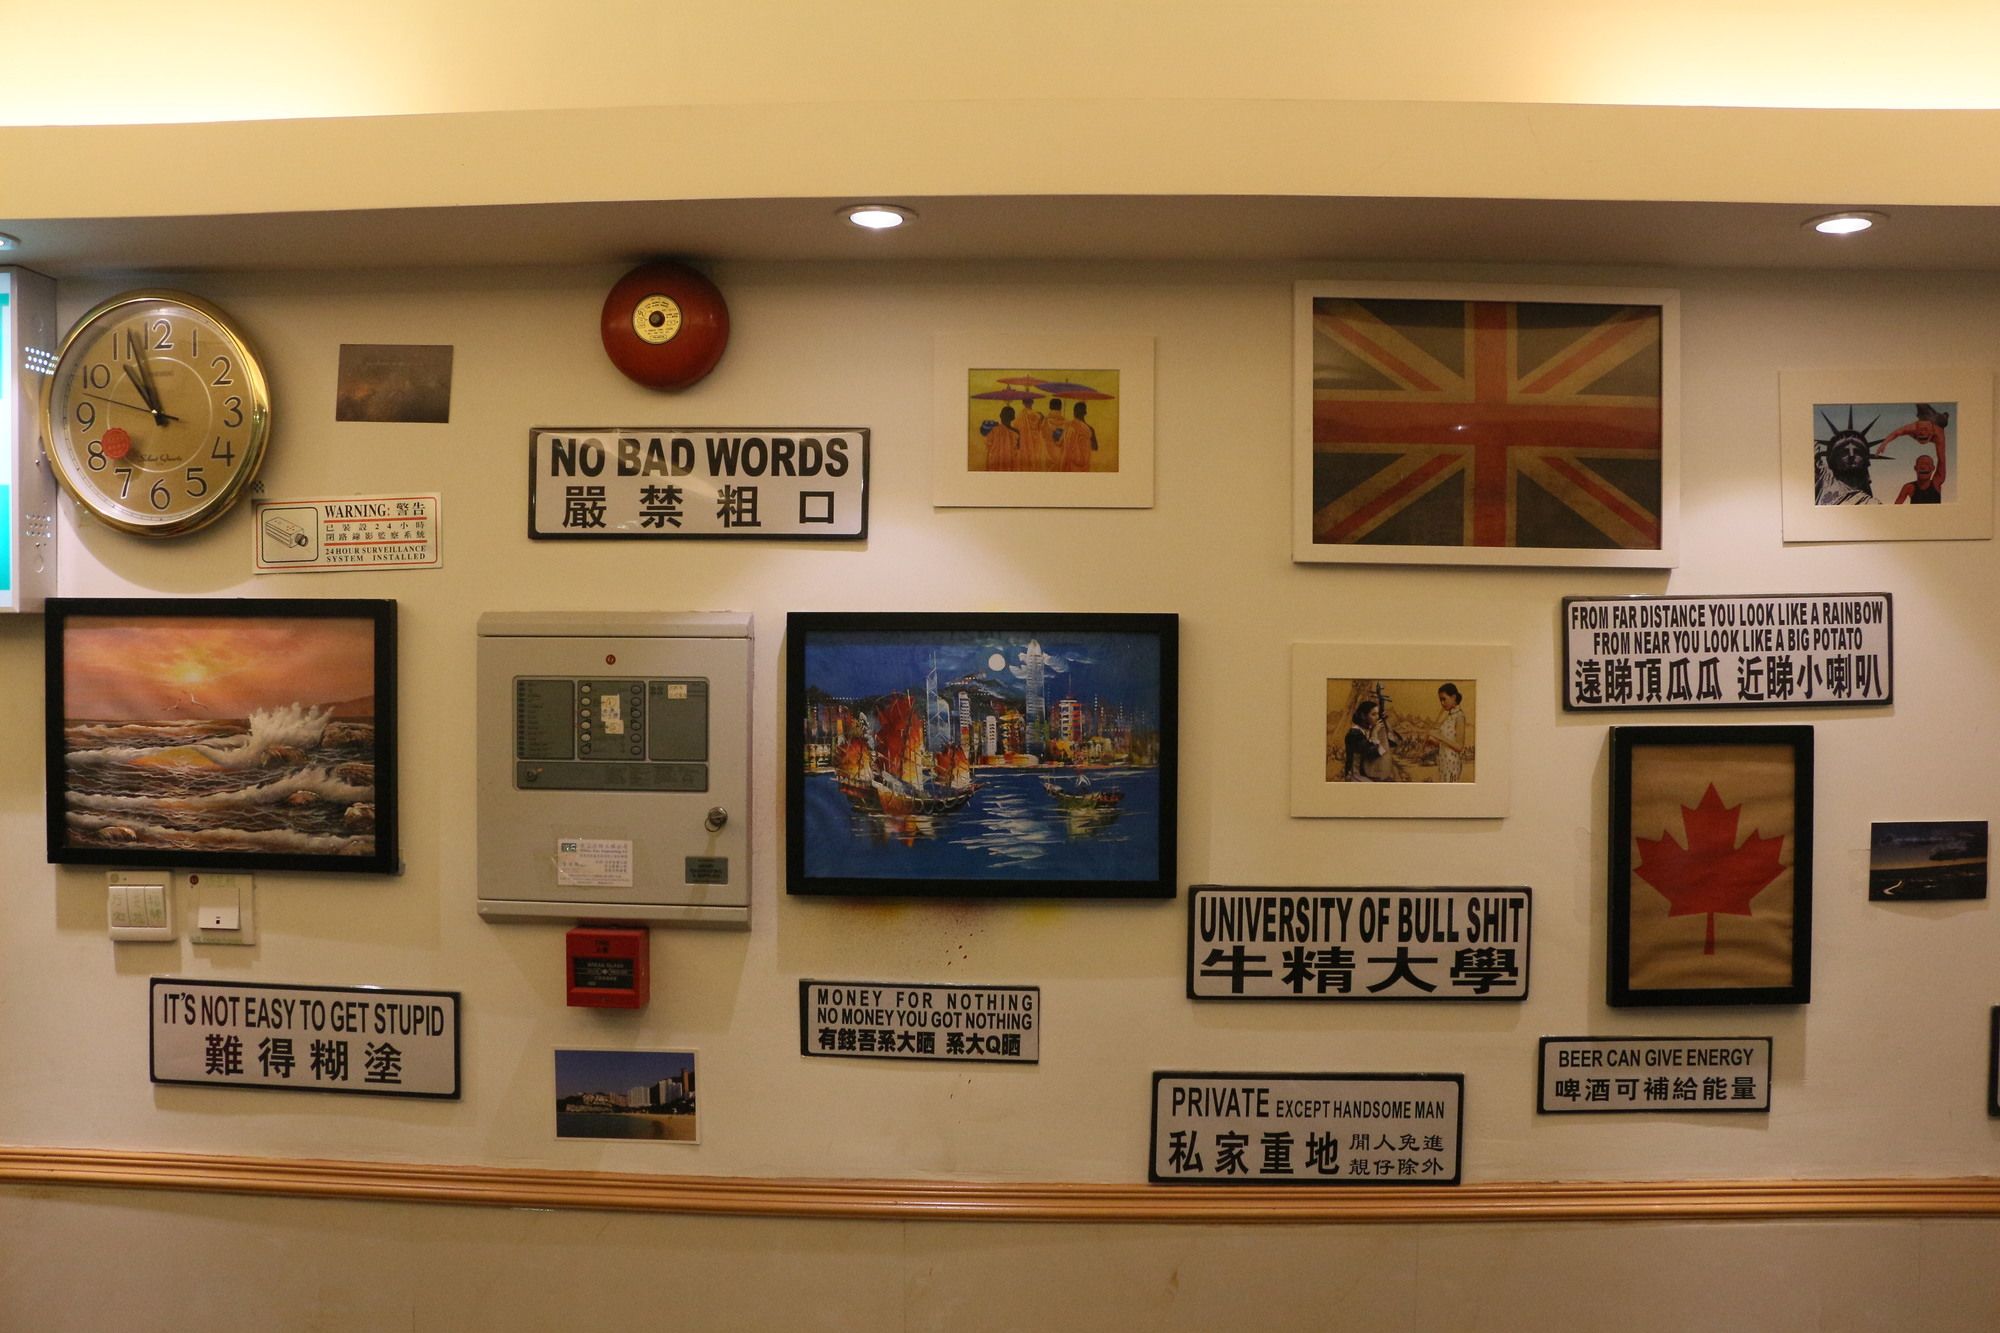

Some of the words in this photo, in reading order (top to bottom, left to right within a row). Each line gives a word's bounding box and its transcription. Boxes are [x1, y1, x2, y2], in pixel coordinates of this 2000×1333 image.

[144, 320, 172, 350] 12
[192, 330, 196, 357] 1
[83, 364, 110, 388] 10
[211, 356, 232, 386] 2
[76, 402, 96, 432] 9
[224, 397, 243, 427] 3
[88, 441, 106, 470] 8
[211, 436, 234, 466] 4
[551, 438, 605, 476] NO
[618, 438, 695, 476] BAD
[706, 438, 848, 476] WORDS
[114, 468, 132, 498] 7
[151, 479, 170, 510] 6
[186, 468, 207, 496] 5
[325, 504, 390, 517] WARNING:
[397, 502, 425, 515] 警告
[562, 485, 834, 528] 嚴禁粗口
[1572, 607, 1608, 629] FROM
[1613, 606, 1637, 628] FAR
[1641, 604, 1705, 628] DISTANCE
[1709, 604, 1735, 627] YOU
[1740, 603, 1775, 626] LOOK
[1779, 603, 1807, 625] LIKE
[1811, 602, 1819, 624] A
[1823, 601, 1883, 624] RAINBOW
[1594, 632, 1630, 655] FROM
[1634, 631, 1670, 654] NEAR
[1673, 630, 1699, 653] YOU
[1704, 630, 1739, 652] LOOK
[1743, 629, 1772, 651] LIKE
[1775, 629, 1784, 651] A
[1788, 628, 1809, 651] BIG
[1814, 627, 1862, 650] POTATO
[1576, 657, 1722, 704] 遠睇頂瓜瓜
[1738, 654, 1882, 700] 近睇小喇叭
[1201, 897, 1352, 942] UNIVERSITY
[1359, 897, 1390, 942] OF
[1400, 897, 1458, 942] BULL
[1467, 897, 1524, 942] SHIT
[1200, 946, 1518, 994] 牛精大學
[164, 993, 195, 1025] IT'S
[201, 995, 240, 1026] NOT
[245, 997, 295, 1029] EASY
[300, 1000, 325, 1031] TO
[331, 1001, 369, 1032] GET
[374, 1003, 444, 1036] STUPID
[818, 989, 882, 1006] MONEY
[897, 991, 932, 1008] FOR
[947, 993, 1032, 1011] NOTHING
[818, 1008, 838, 1024] NO
[842, 1009, 894, 1026] MONEY
[897, 1011, 927, 1027] YOU
[931, 1012, 962, 1028] GOT
[966, 1013, 1032, 1030] NOTHING
[205, 1034, 402, 1083] 難得糊塗
[1559, 1050, 1603, 1067] BEER
[1607, 1050, 1640, 1067] CAN
[1645, 1049, 1682, 1066] GIVE
[1686, 1049, 1754, 1066] ENERGY
[1172, 1087, 1270, 1118] PRIVATE
[1277, 1100, 1330, 1118] EXCEPT
[1333, 1101, 1411, 1119] HANDSOME
[1415, 1101, 1444, 1119] MAN
[1555, 1077, 1756, 1102] 啤酒可補給能量
[1169, 1130, 1339, 1175] 私家重地
[1348, 1158, 1444, 1175] 靚仔除外
